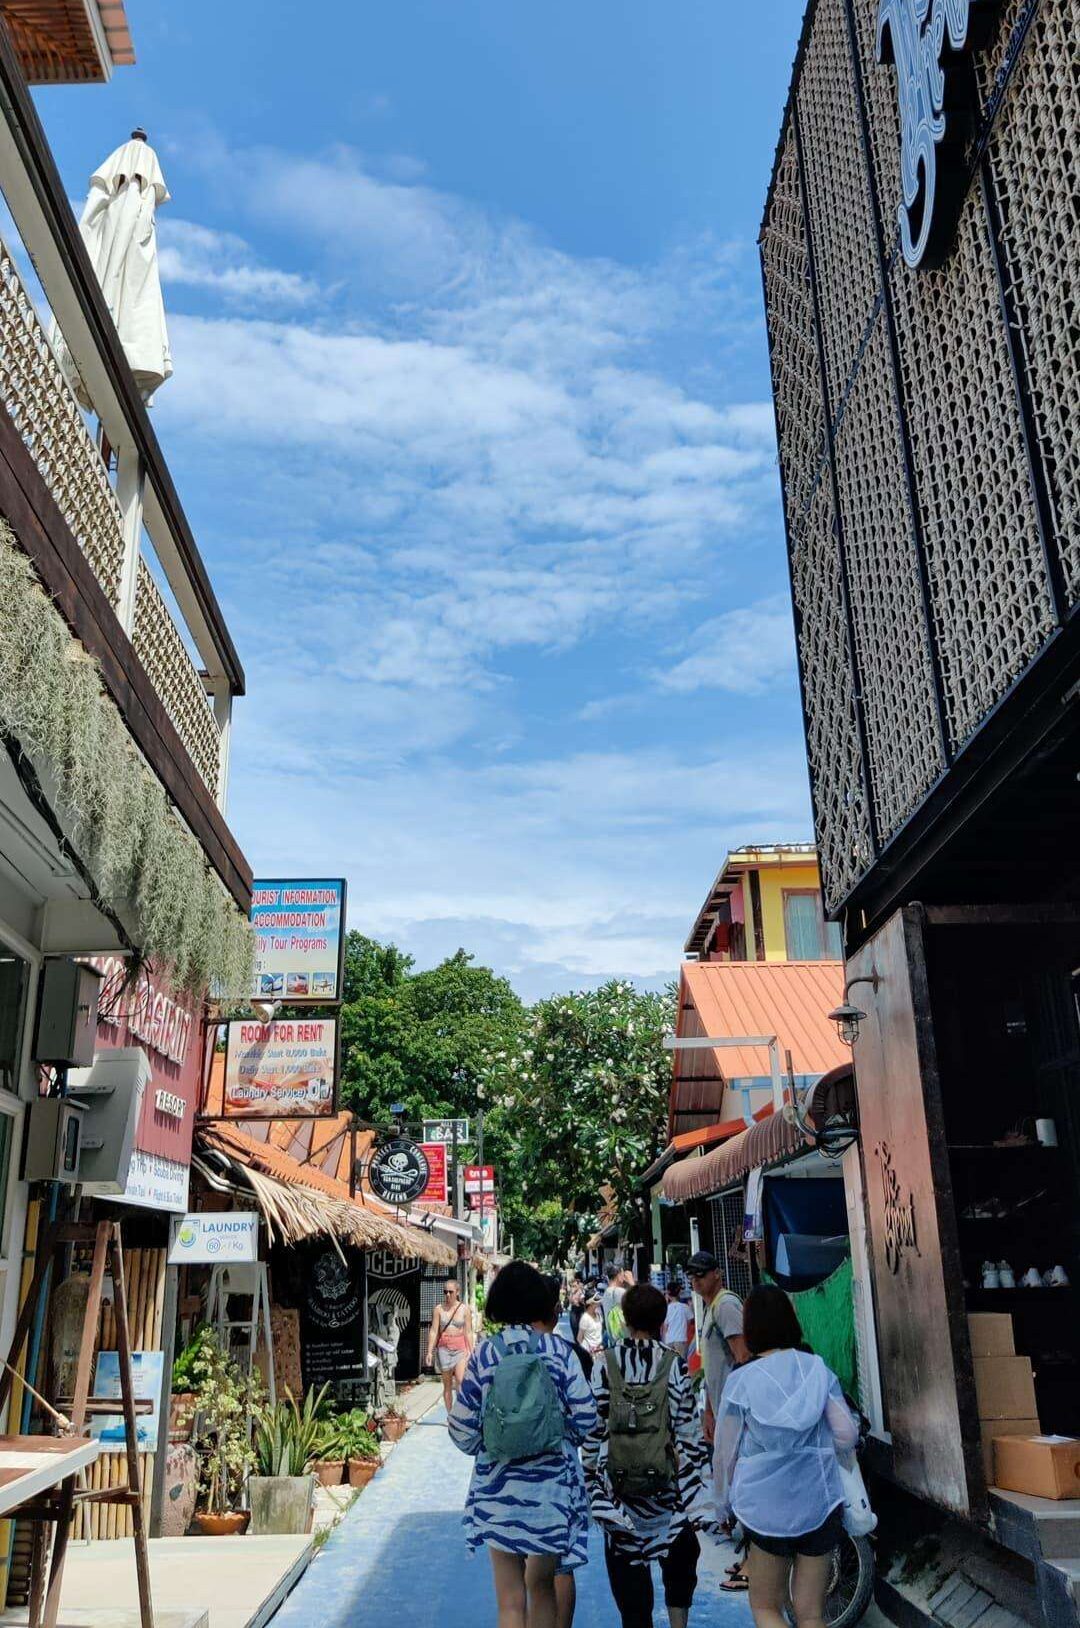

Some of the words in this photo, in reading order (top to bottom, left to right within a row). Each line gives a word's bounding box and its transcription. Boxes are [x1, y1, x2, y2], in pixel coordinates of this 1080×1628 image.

[251, 890, 279, 905] OURIST
[282, 890, 337, 905] INFORMATION
[254, 912, 326, 928] ACCOMMODATION
[270, 936, 287, 950] Tour
[291, 936, 328, 953] Programs
[240, 1025, 270, 1043] ROOM
[274, 1025, 294, 1042] FOR
[297, 1024, 324, 1042] RENT
[159, 1091, 186, 1117] RESORT
[203, 1222, 254, 1233] LAUNDRY
